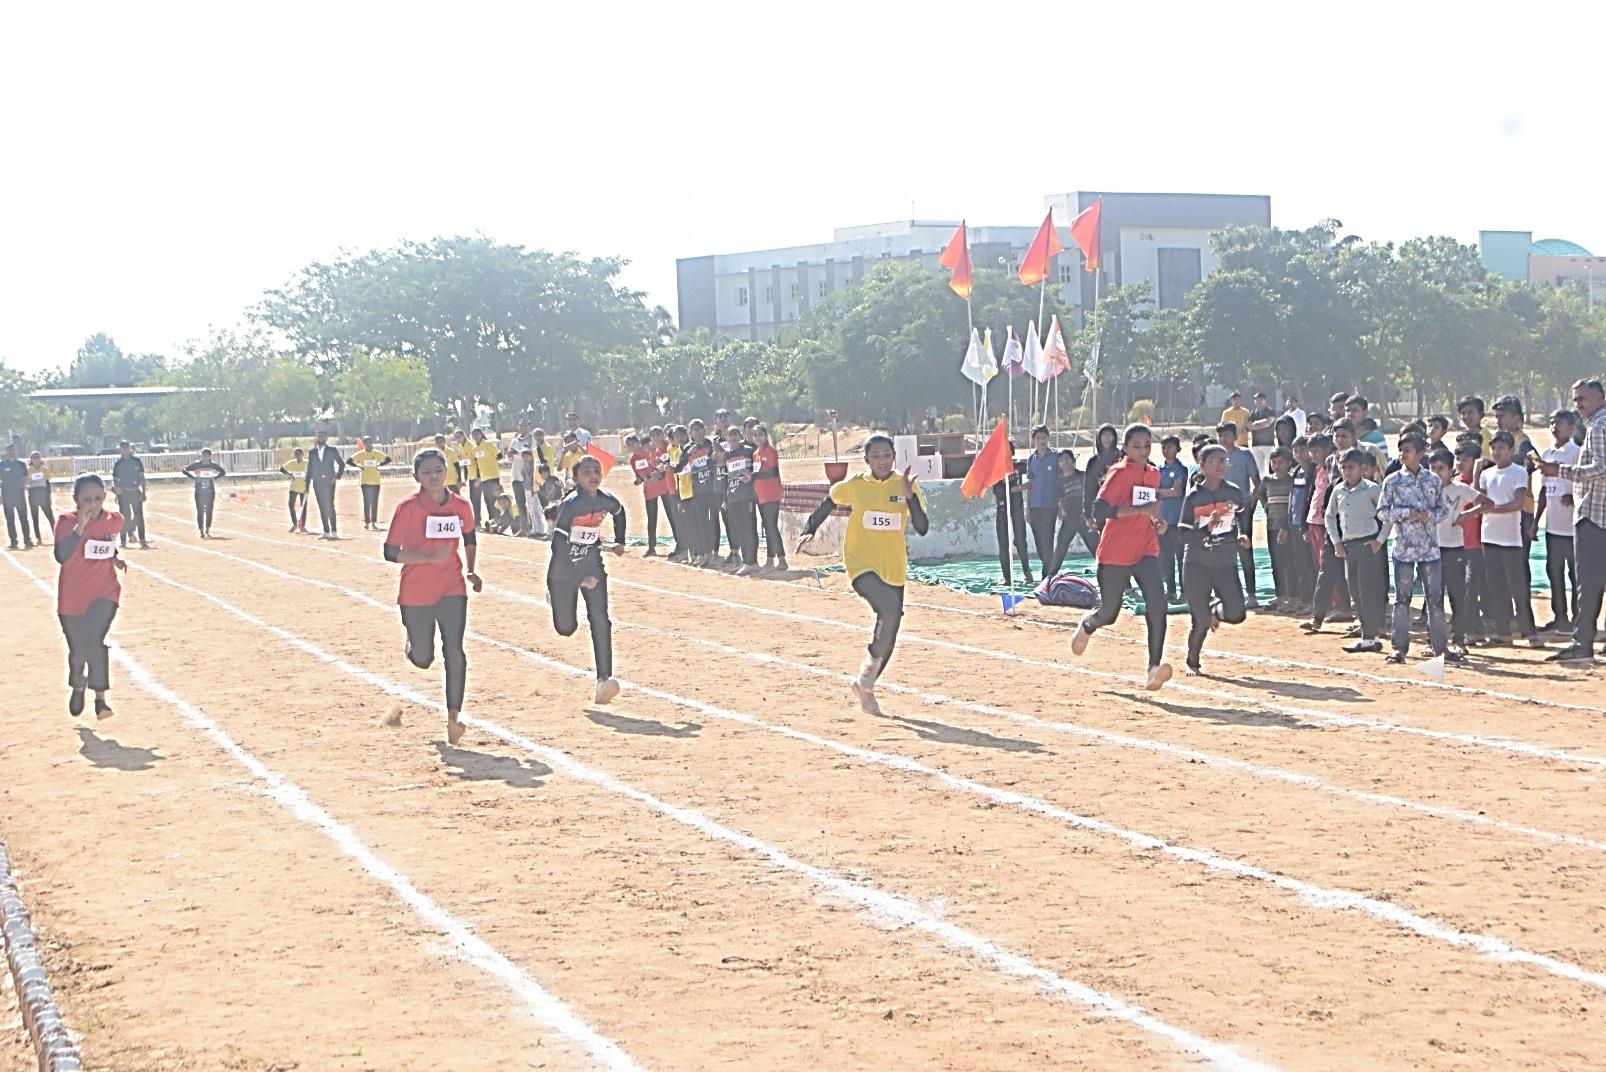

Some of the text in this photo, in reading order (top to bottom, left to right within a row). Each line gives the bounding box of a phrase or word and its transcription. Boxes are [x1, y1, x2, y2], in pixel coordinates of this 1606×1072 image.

[927, 459, 933, 474] 3
[872, 516, 891, 527] 155
[437, 522, 456, 533] 140
[580, 530, 597, 541] 175
[93, 545, 110, 555] 168
